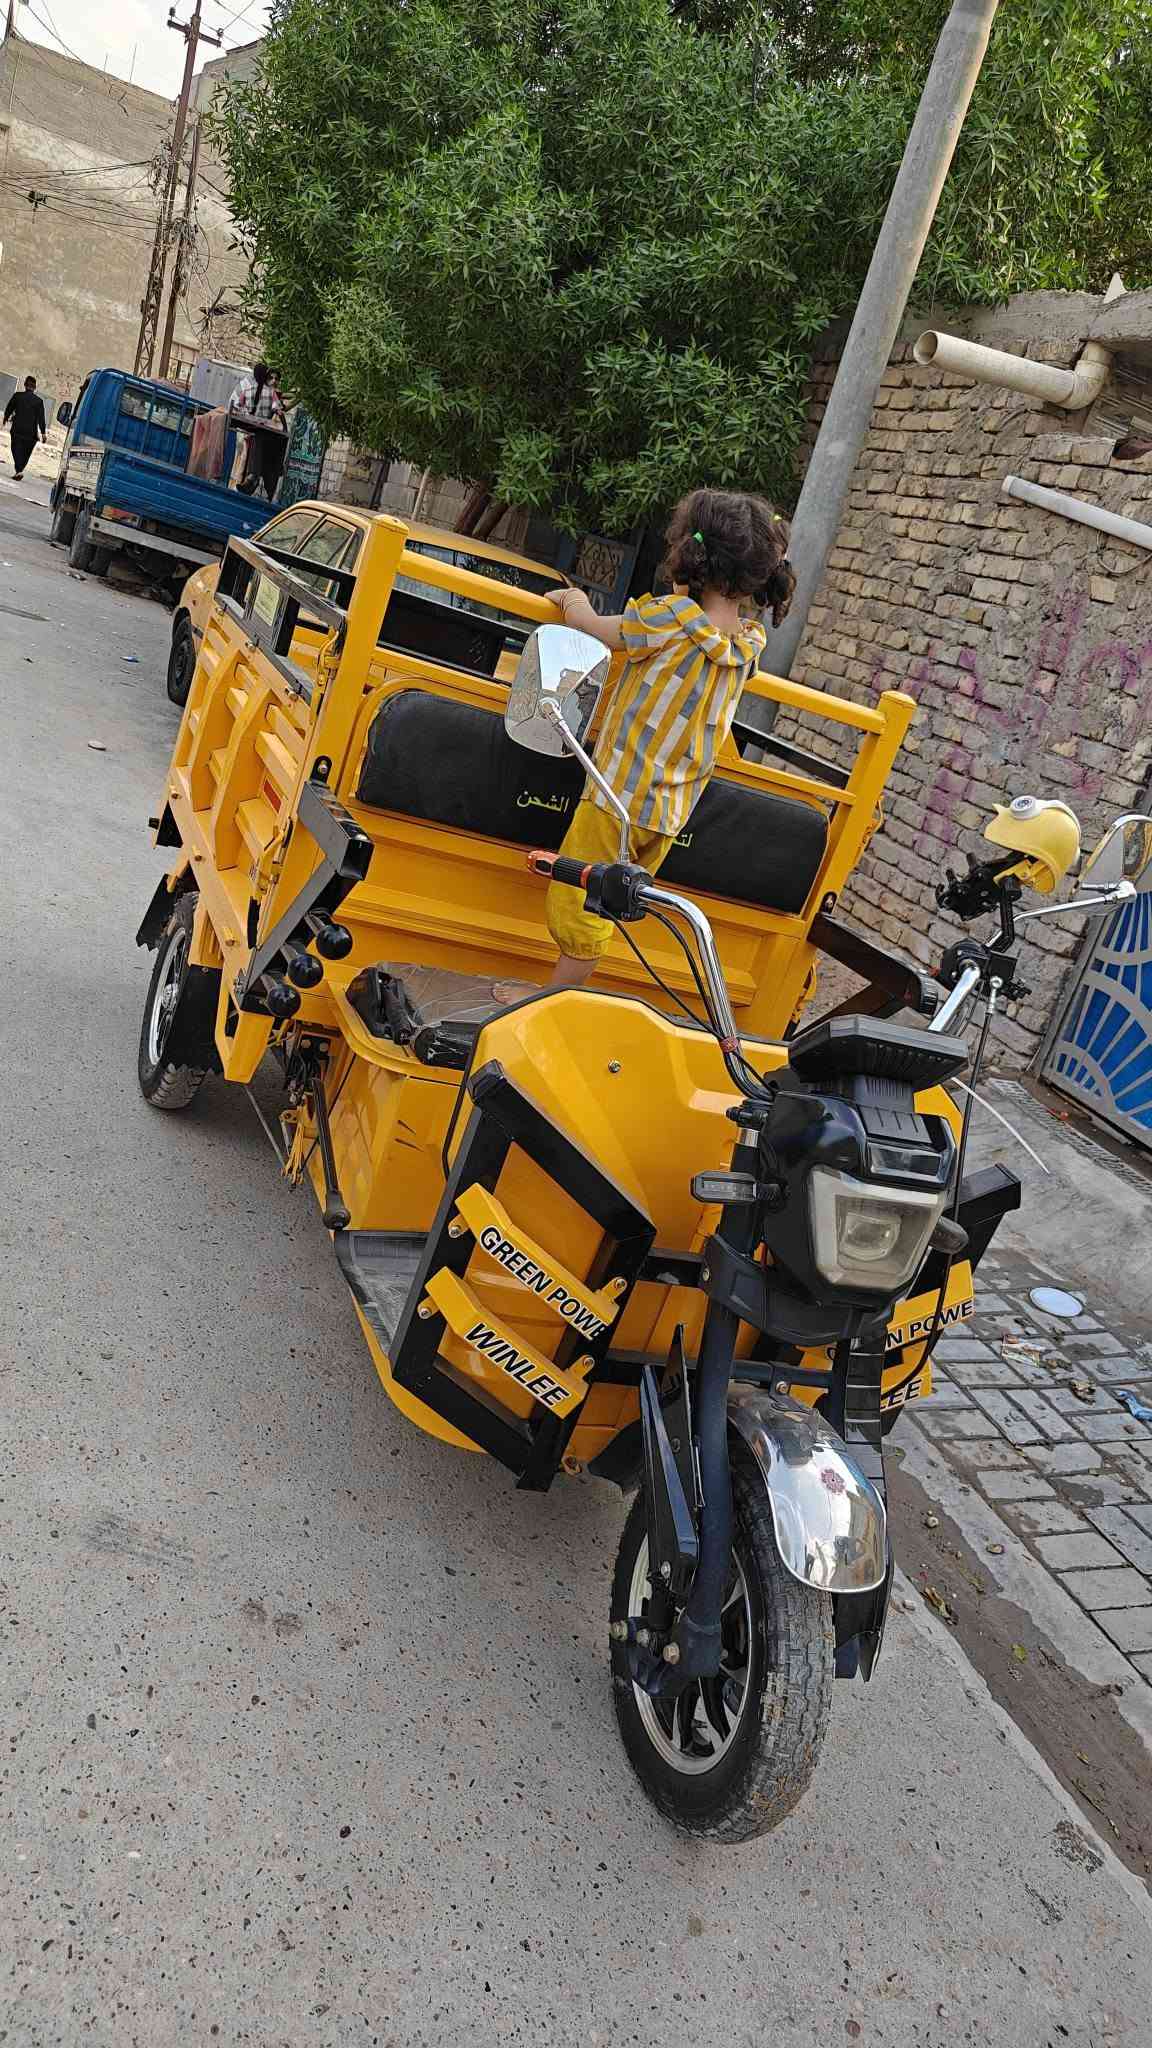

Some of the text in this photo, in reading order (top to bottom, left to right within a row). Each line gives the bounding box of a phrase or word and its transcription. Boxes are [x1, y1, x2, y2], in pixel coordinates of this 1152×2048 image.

[516, 791, 570, 814] الشحن
[481, 1226, 553, 1293] GREEN
[465, 1322, 570, 1407] WINLEE
